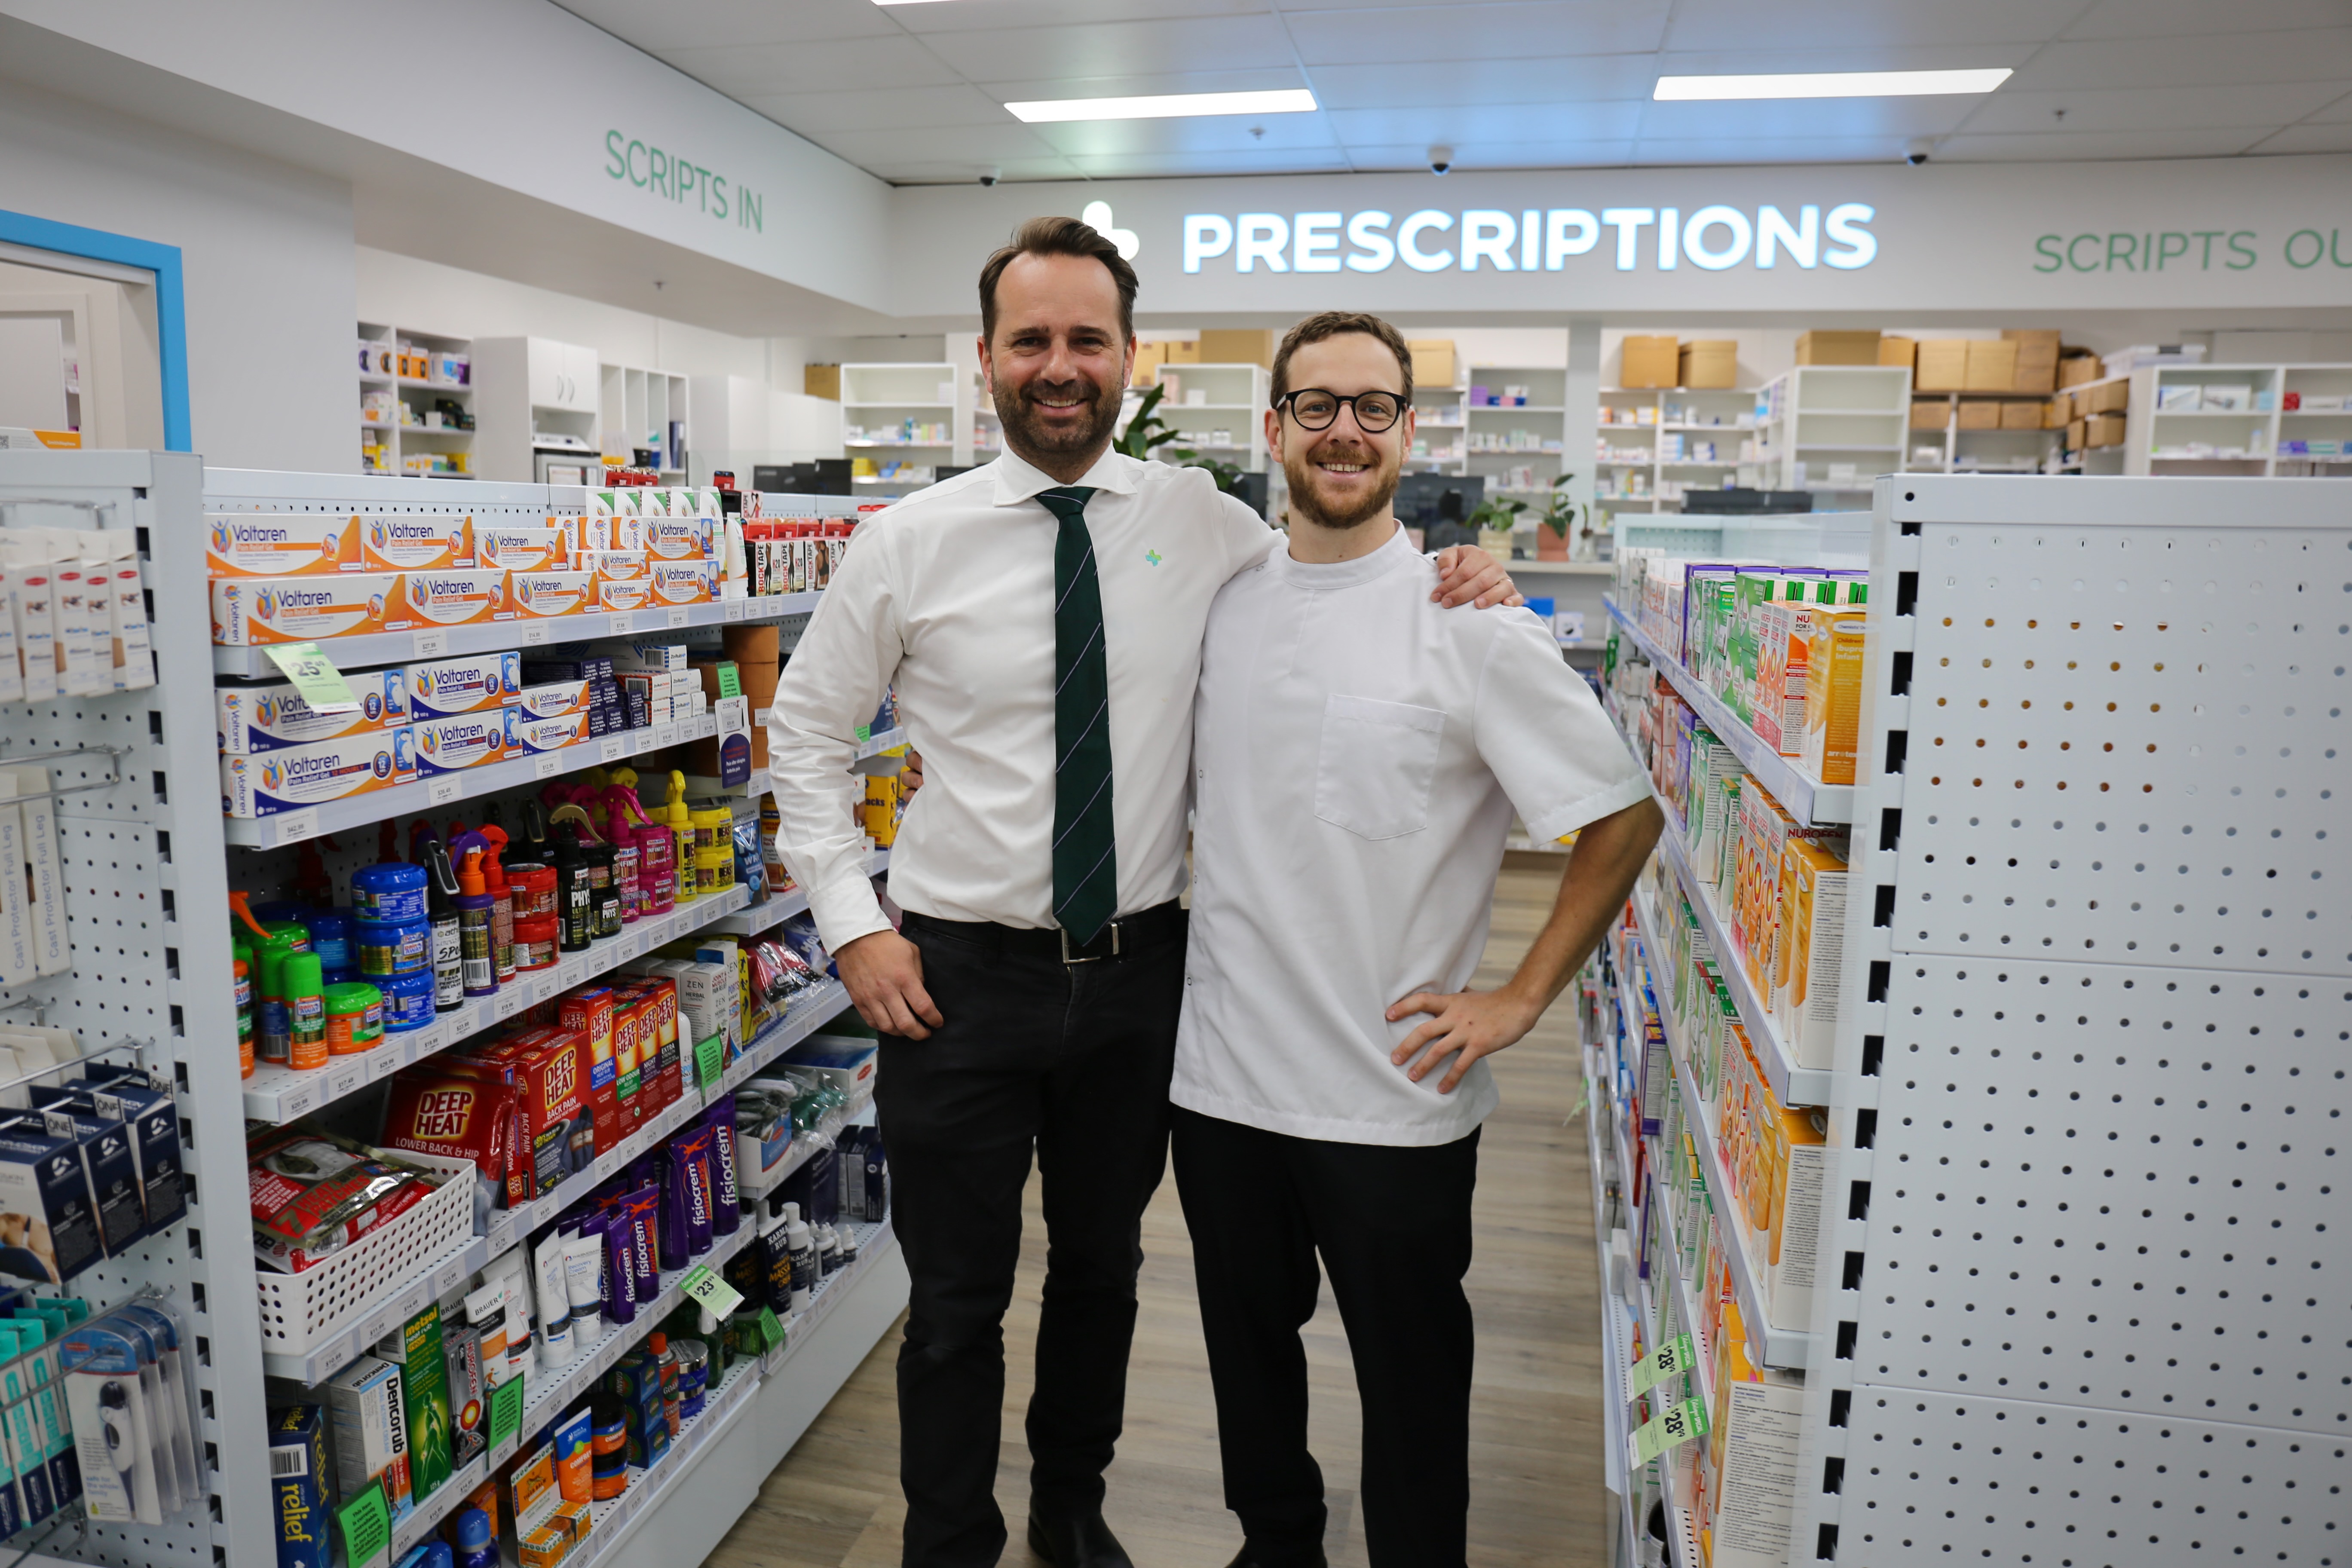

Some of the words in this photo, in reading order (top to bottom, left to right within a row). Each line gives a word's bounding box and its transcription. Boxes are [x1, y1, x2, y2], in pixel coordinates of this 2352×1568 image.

[606, 130, 728, 218] SCRIPTS
[738, 185, 762, 233] IN
[1182, 203, 1878, 274] PRESCRIPTIONS
[2033, 231, 2257, 273] SCRIPTS
[233, 524, 287, 541] Voltaren
[388, 523, 434, 538] Voltaren
[498, 536, 528, 546] Voltaren
[658, 524, 688, 536] Voltaren
[609, 556, 631, 564] Voltaren
[532, 580, 562, 591] Voltaren
[666, 568, 695, 580] Voltaren
[277, 591, 332, 607] Voltaren
[429, 580, 474, 594] Voltaren
[612, 585, 635, 594] Voltaren
[231, 601, 240, 642] Voltaren
[1835, 652, 1860, 661] Infant
[434, 668, 480, 685] Voltaren
[539, 692, 562, 701] Voltaren
[232, 710, 240, 750] Voltaren
[438, 724, 483, 741] Voltaren
[539, 724, 562, 734] Voltaren
[284, 755, 340, 775] Voltaren
[301, 775, 319, 783] Relief
[320, 772, 330, 780] Gel
[237, 774, 246, 814] Voltaren
[3, 825, 13, 850] Leg
[35, 815, 46, 839] Leg
[1787, 828, 1843, 838] NUROFEN
[5, 852, 14, 876] Full
[38, 842, 48, 865] Full
[8, 879, 21, 938] Protector
[41, 869, 55, 926] Protector
[14, 941, 24, 970] Cast
[48, 930, 58, 959] Cast
[687, 980, 704, 989] ZEN
[657, 994, 675, 1016] DEEP
[658, 1005, 675, 1027] HEAT
[563, 1012, 585, 1024] DEEP
[591, 1006, 611, 1032] DEEP
[638, 1007, 656, 1031] DEEP
[592, 1018, 611, 1044] HEAT
[617, 1020, 636, 1044] DEEP
[640, 1019, 657, 1043] HEAT
[618, 1032, 637, 1057] HEAT
[661, 1043, 675, 1054] EXTRA
[545, 1049, 575, 1089] DEEP
[593, 1060, 613, 1075] ORIGINAL
[643, 1057, 656, 1069] NIGHT
[151, 1078, 171, 1093] ONE
[517, 1075, 527, 1095] DEEP
[546, 1066, 576, 1107] HEAT
[616, 1076, 626, 1086] LOW
[626, 1068, 640, 1081] ODOUR
[96, 1097, 118, 1113] ONE
[420, 1091, 472, 1114] DEEP
[547, 1103, 562, 1120] BACK
[563, 1096, 576, 1113] PAIN
[47, 1119, 70, 1133] ONE
[415, 1112, 468, 1136] HEAT
[395, 1137, 427, 1152] LOWER
[428, 1141, 453, 1156] BACK
[455, 1147, 463, 1157] &
[464, 1149, 480, 1160] HIP
[698, 1158, 708, 1188] Ease
[717, 1124, 737, 1207] fisiocrem
[295, 1180, 334, 1210] HEAT
[309, 1174, 371, 1216] PATCHES
[688, 1162, 705, 1226] fisiocrem
[700, 1191, 711, 1220] Joint
[276, 1209, 305, 1234] 7
[644, 1219, 654, 1245] Ease
[635, 1220, 650, 1278] fisiocrem
[774, 1236, 787, 1250] RUB
[649, 1248, 657, 1273] Joint
[625, 1247, 635, 1303] fisiocrem
[475, 1297, 499, 1316] BRAUER
[405, 1307, 438, 1337] metsal
[406, 1329, 418, 1344] heat
[419, 1323, 432, 1334] rub
[352, 1362, 390, 1388] Dencorub
[466, 1339, 478, 1396] NUROFEN
[386, 1376, 403, 1454] Dencorub
[570, 1448, 592, 1469] COMFREY
[281, 1483, 312, 1542] relief
